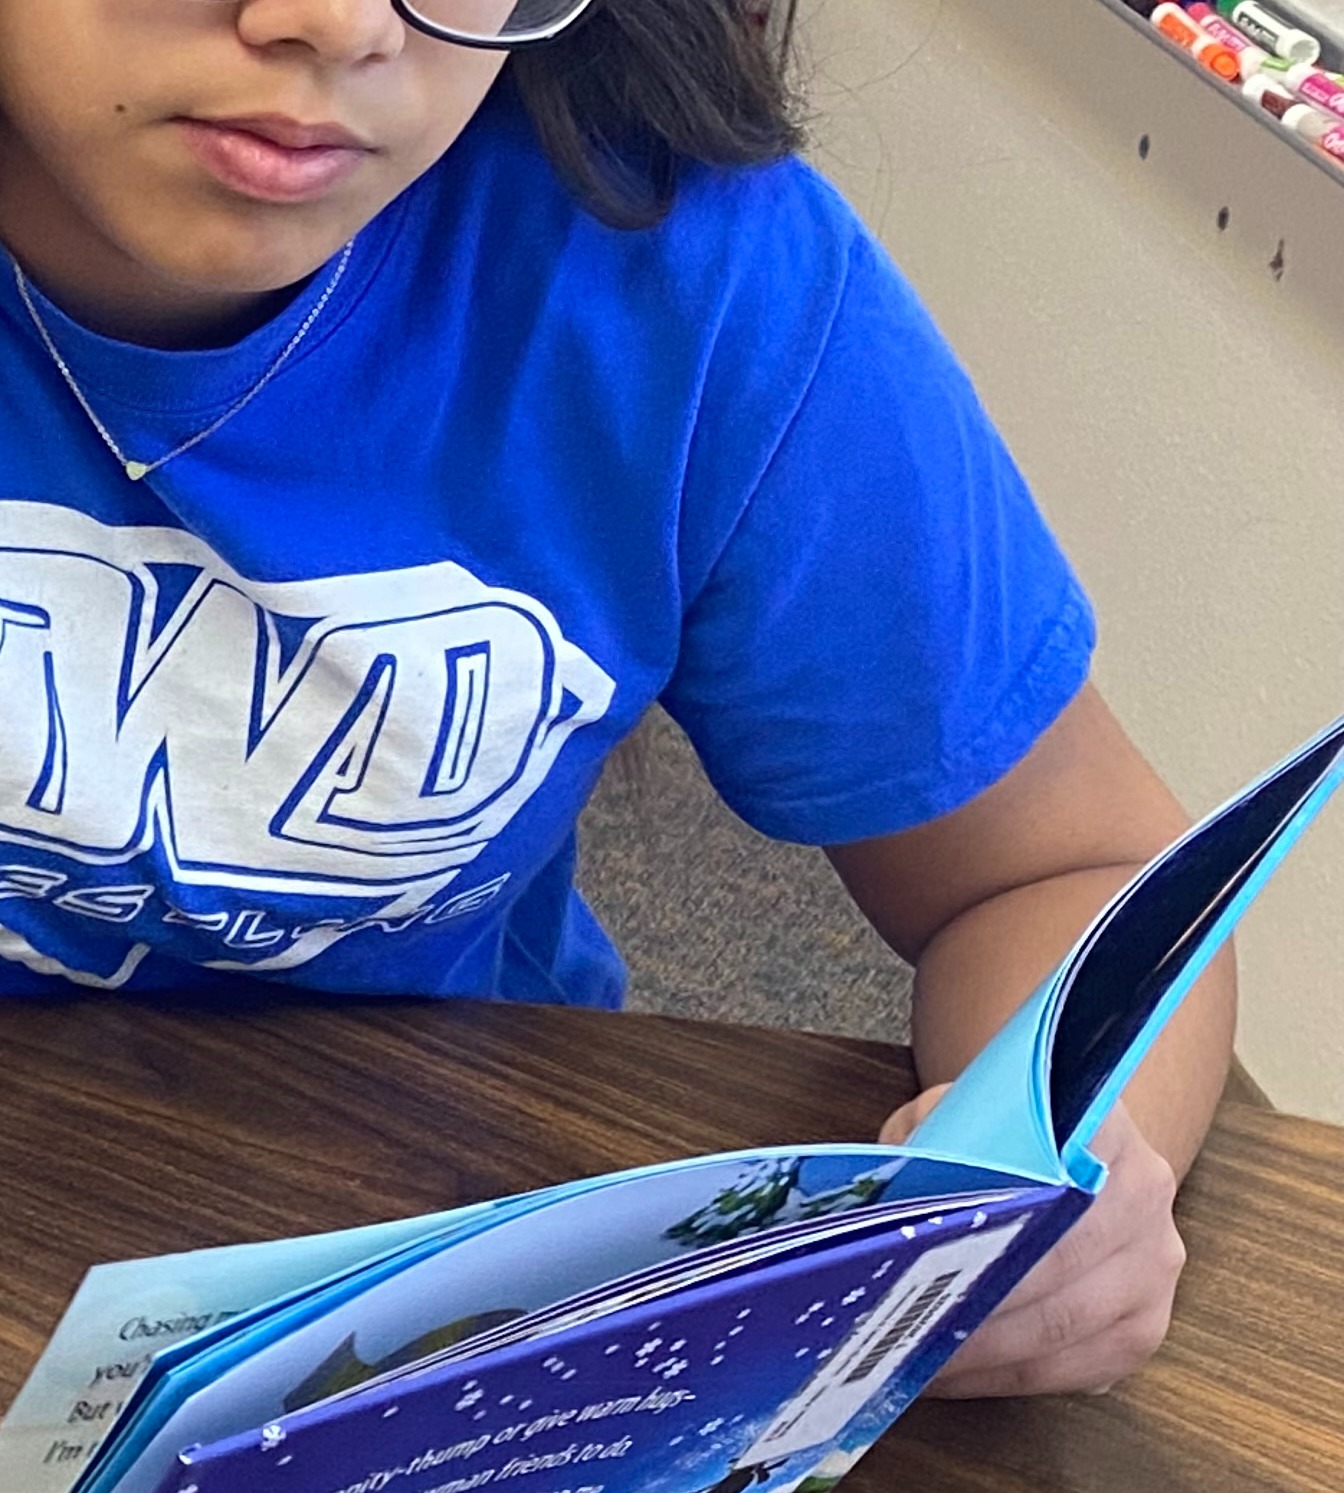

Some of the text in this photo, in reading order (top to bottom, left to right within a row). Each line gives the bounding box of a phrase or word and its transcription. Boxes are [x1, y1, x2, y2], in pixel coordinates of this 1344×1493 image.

[492, 1423, 526, 1445] or
[520, 1409, 578, 1442] give
[575, 1396, 643, 1423] warm
[493, 1443, 578, 1482] friends
[572, 1443, 604, 1464] to
